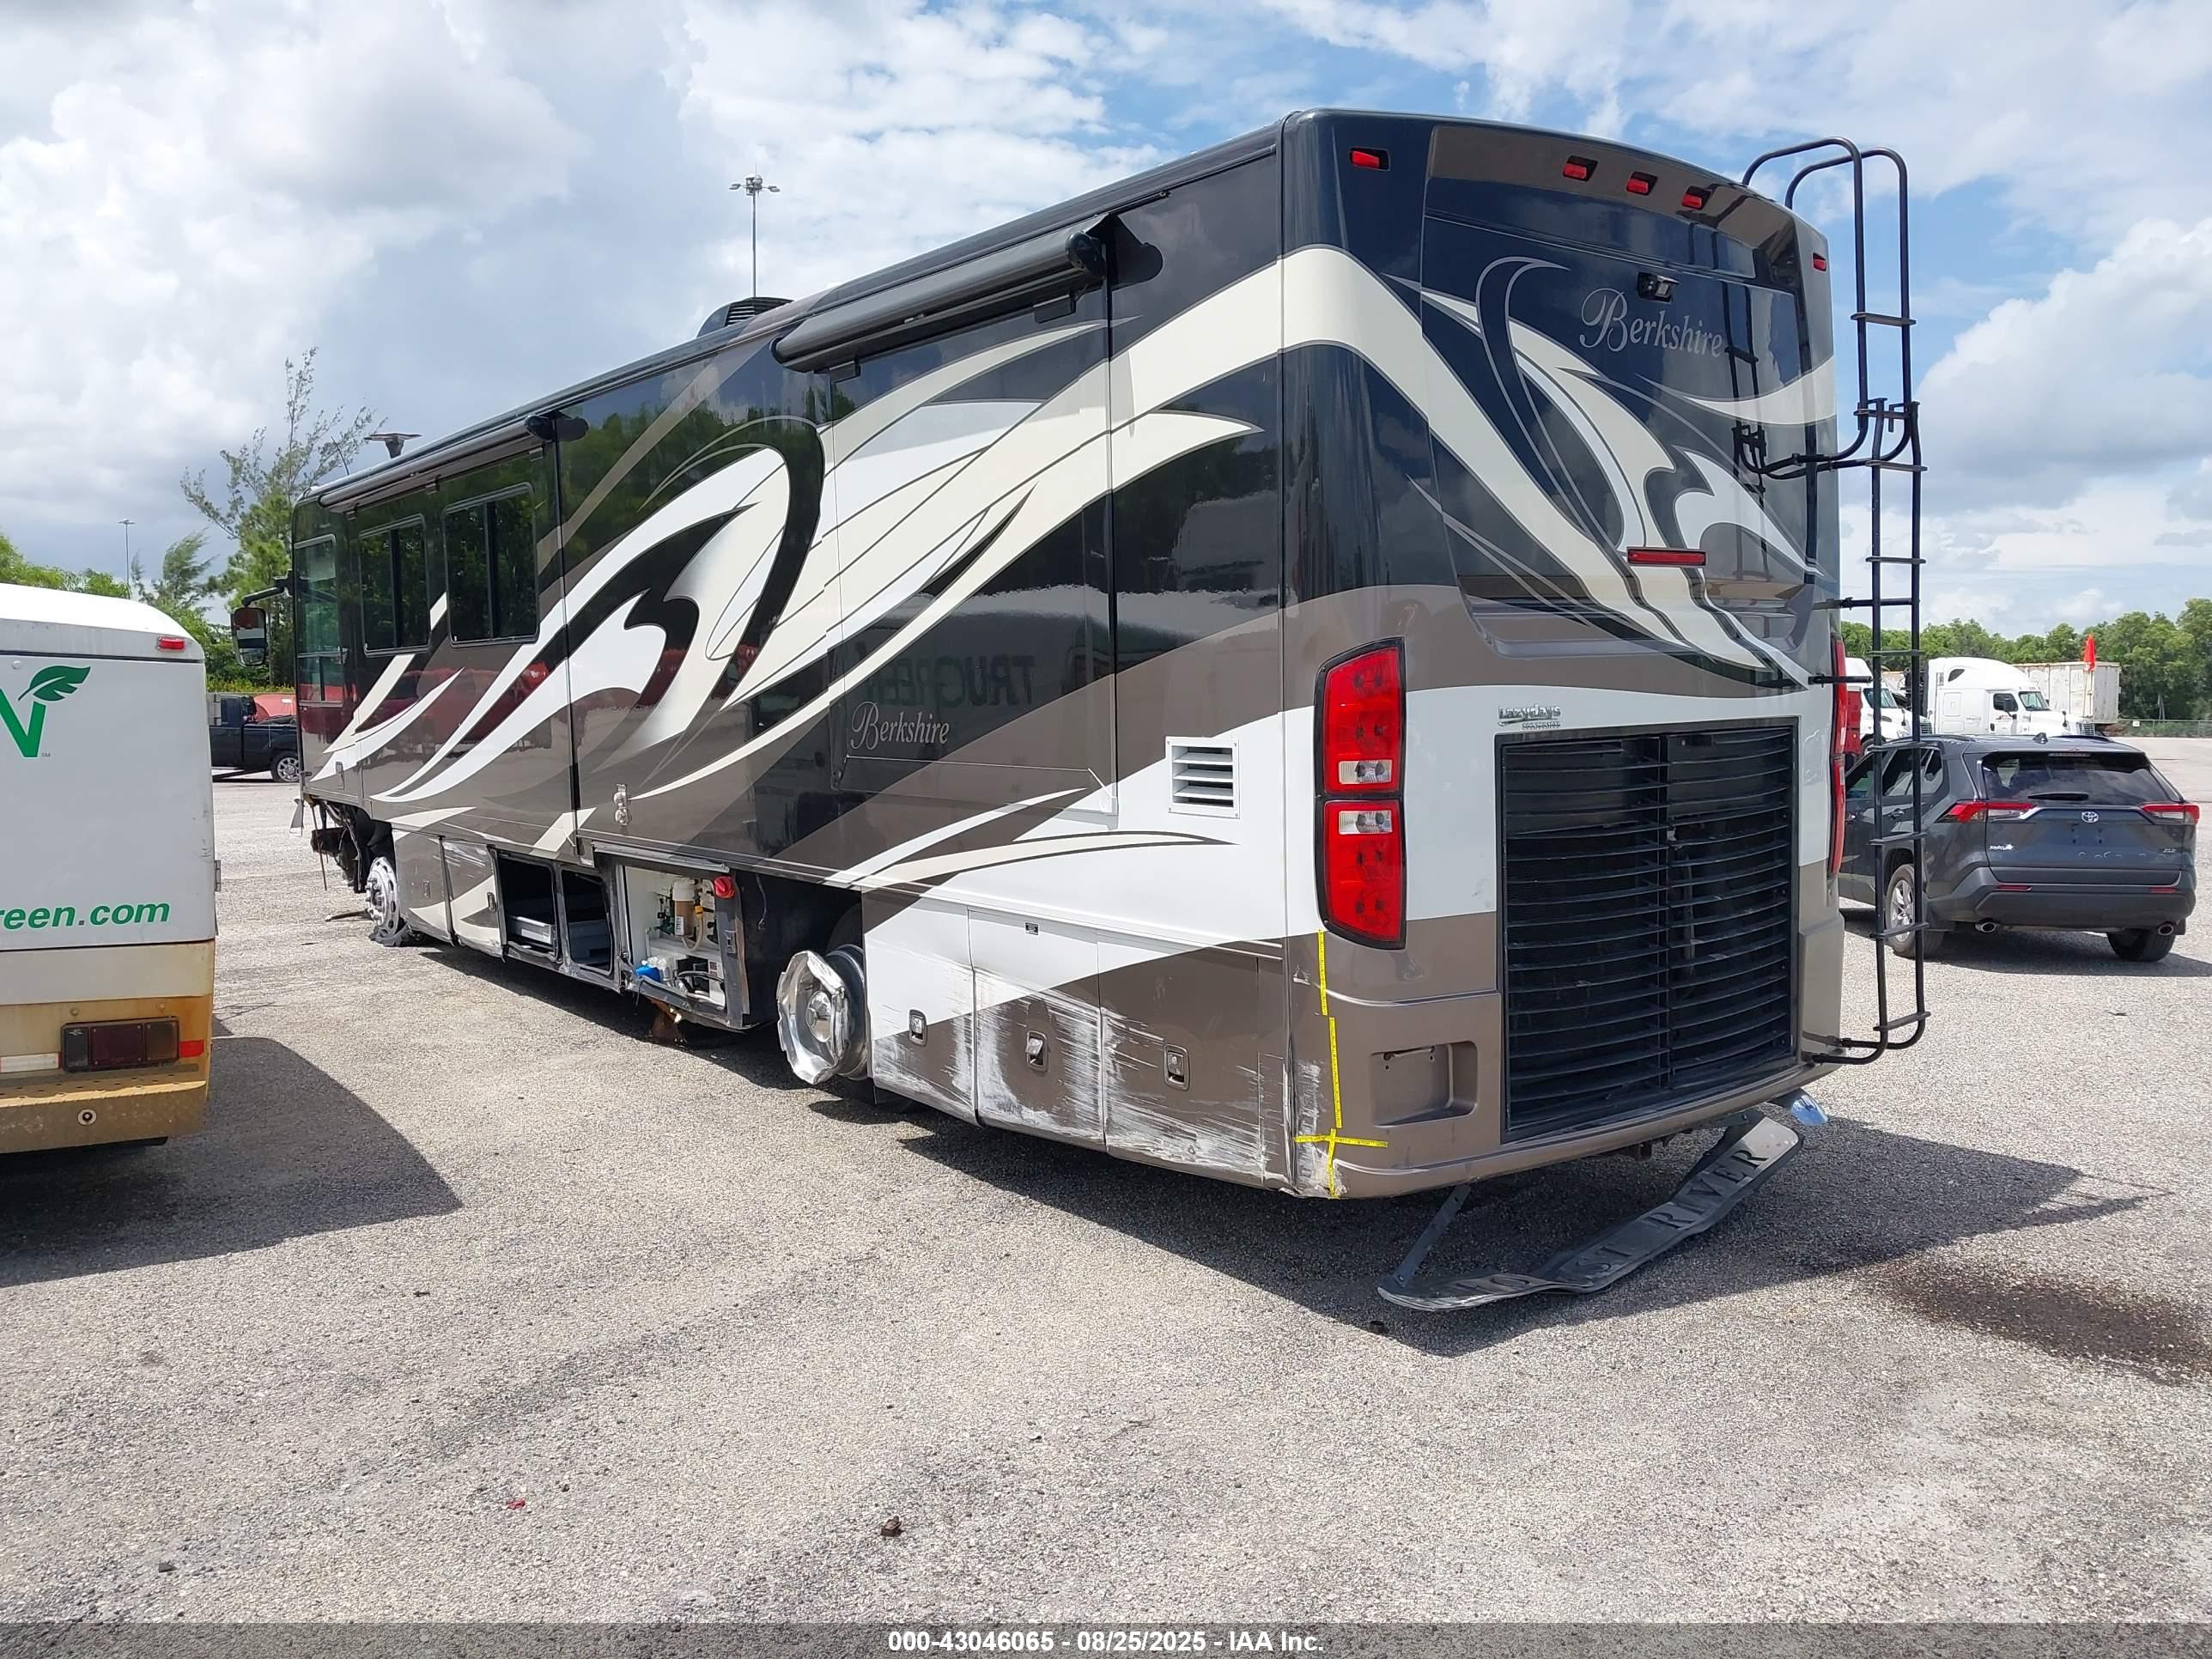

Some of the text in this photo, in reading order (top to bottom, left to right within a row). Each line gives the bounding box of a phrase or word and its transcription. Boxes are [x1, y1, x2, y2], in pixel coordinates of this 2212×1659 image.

[1579, 288, 1723, 357] Berkshire
[850, 702, 950, 750] Berkshire
[1645, 1148, 1771, 1231] RIVER
